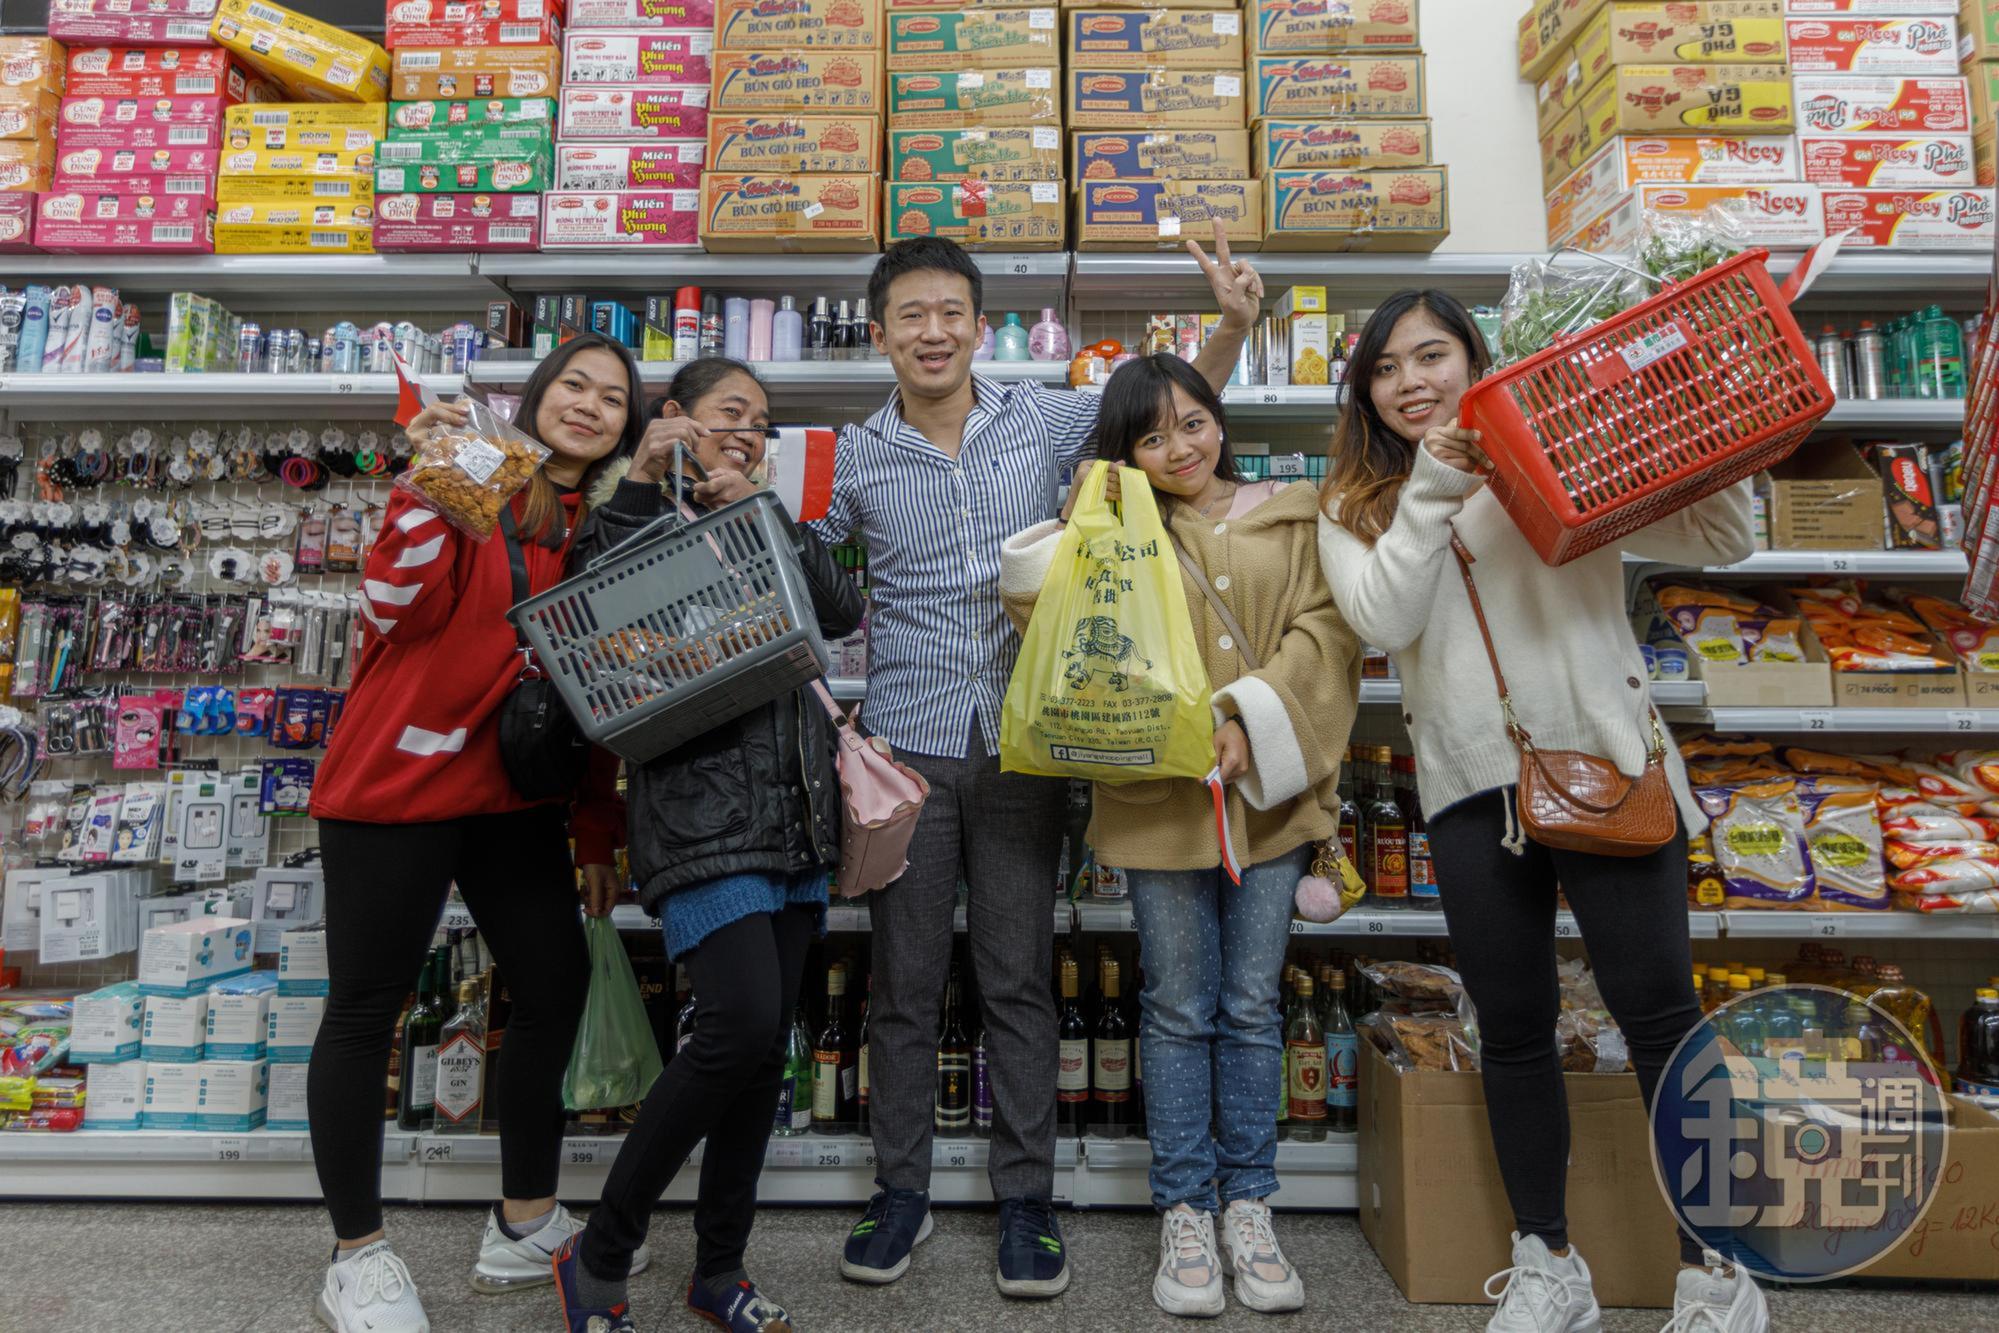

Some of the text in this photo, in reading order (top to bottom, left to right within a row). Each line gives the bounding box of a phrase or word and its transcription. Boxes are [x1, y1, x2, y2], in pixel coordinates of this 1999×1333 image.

[799, 18, 823, 28] HEO
[1854, 25, 1900, 43] Ricey
[796, 77, 821, 88] HEO
[1853, 107, 1899, 128] Ricey
[792, 142, 817, 153] HEO
[1724, 139, 1785, 165] Ricey
[1871, 144, 1918, 164] Ricey
[1745, 190, 1808, 215] Ricey
[1893, 196, 1941, 217] Ricey
[1014, 264, 1027, 273] 40
[339, 384, 352, 394] 99
[1264, 394, 1277, 403] 80
[1280, 464, 1297, 473] 195
[1833, 560, 1847, 570] 52
[1103, 700, 1118, 708] FAX
[1811, 719, 1824, 729] 22
[1958, 720, 1972, 729] 22
[448, 915, 469, 926] 235
[1369, 922, 1383, 932] 80
[1821, 925, 1835, 935] 42
[440, 1057, 481, 1065] GILBEY'S
[450, 1079, 467, 1087] GIN
[218, 1151, 240, 1160] 199
[571, 1152, 593, 1163] 399
[818, 1155, 840, 1165] 250
[950, 1156, 965, 1166] 90
